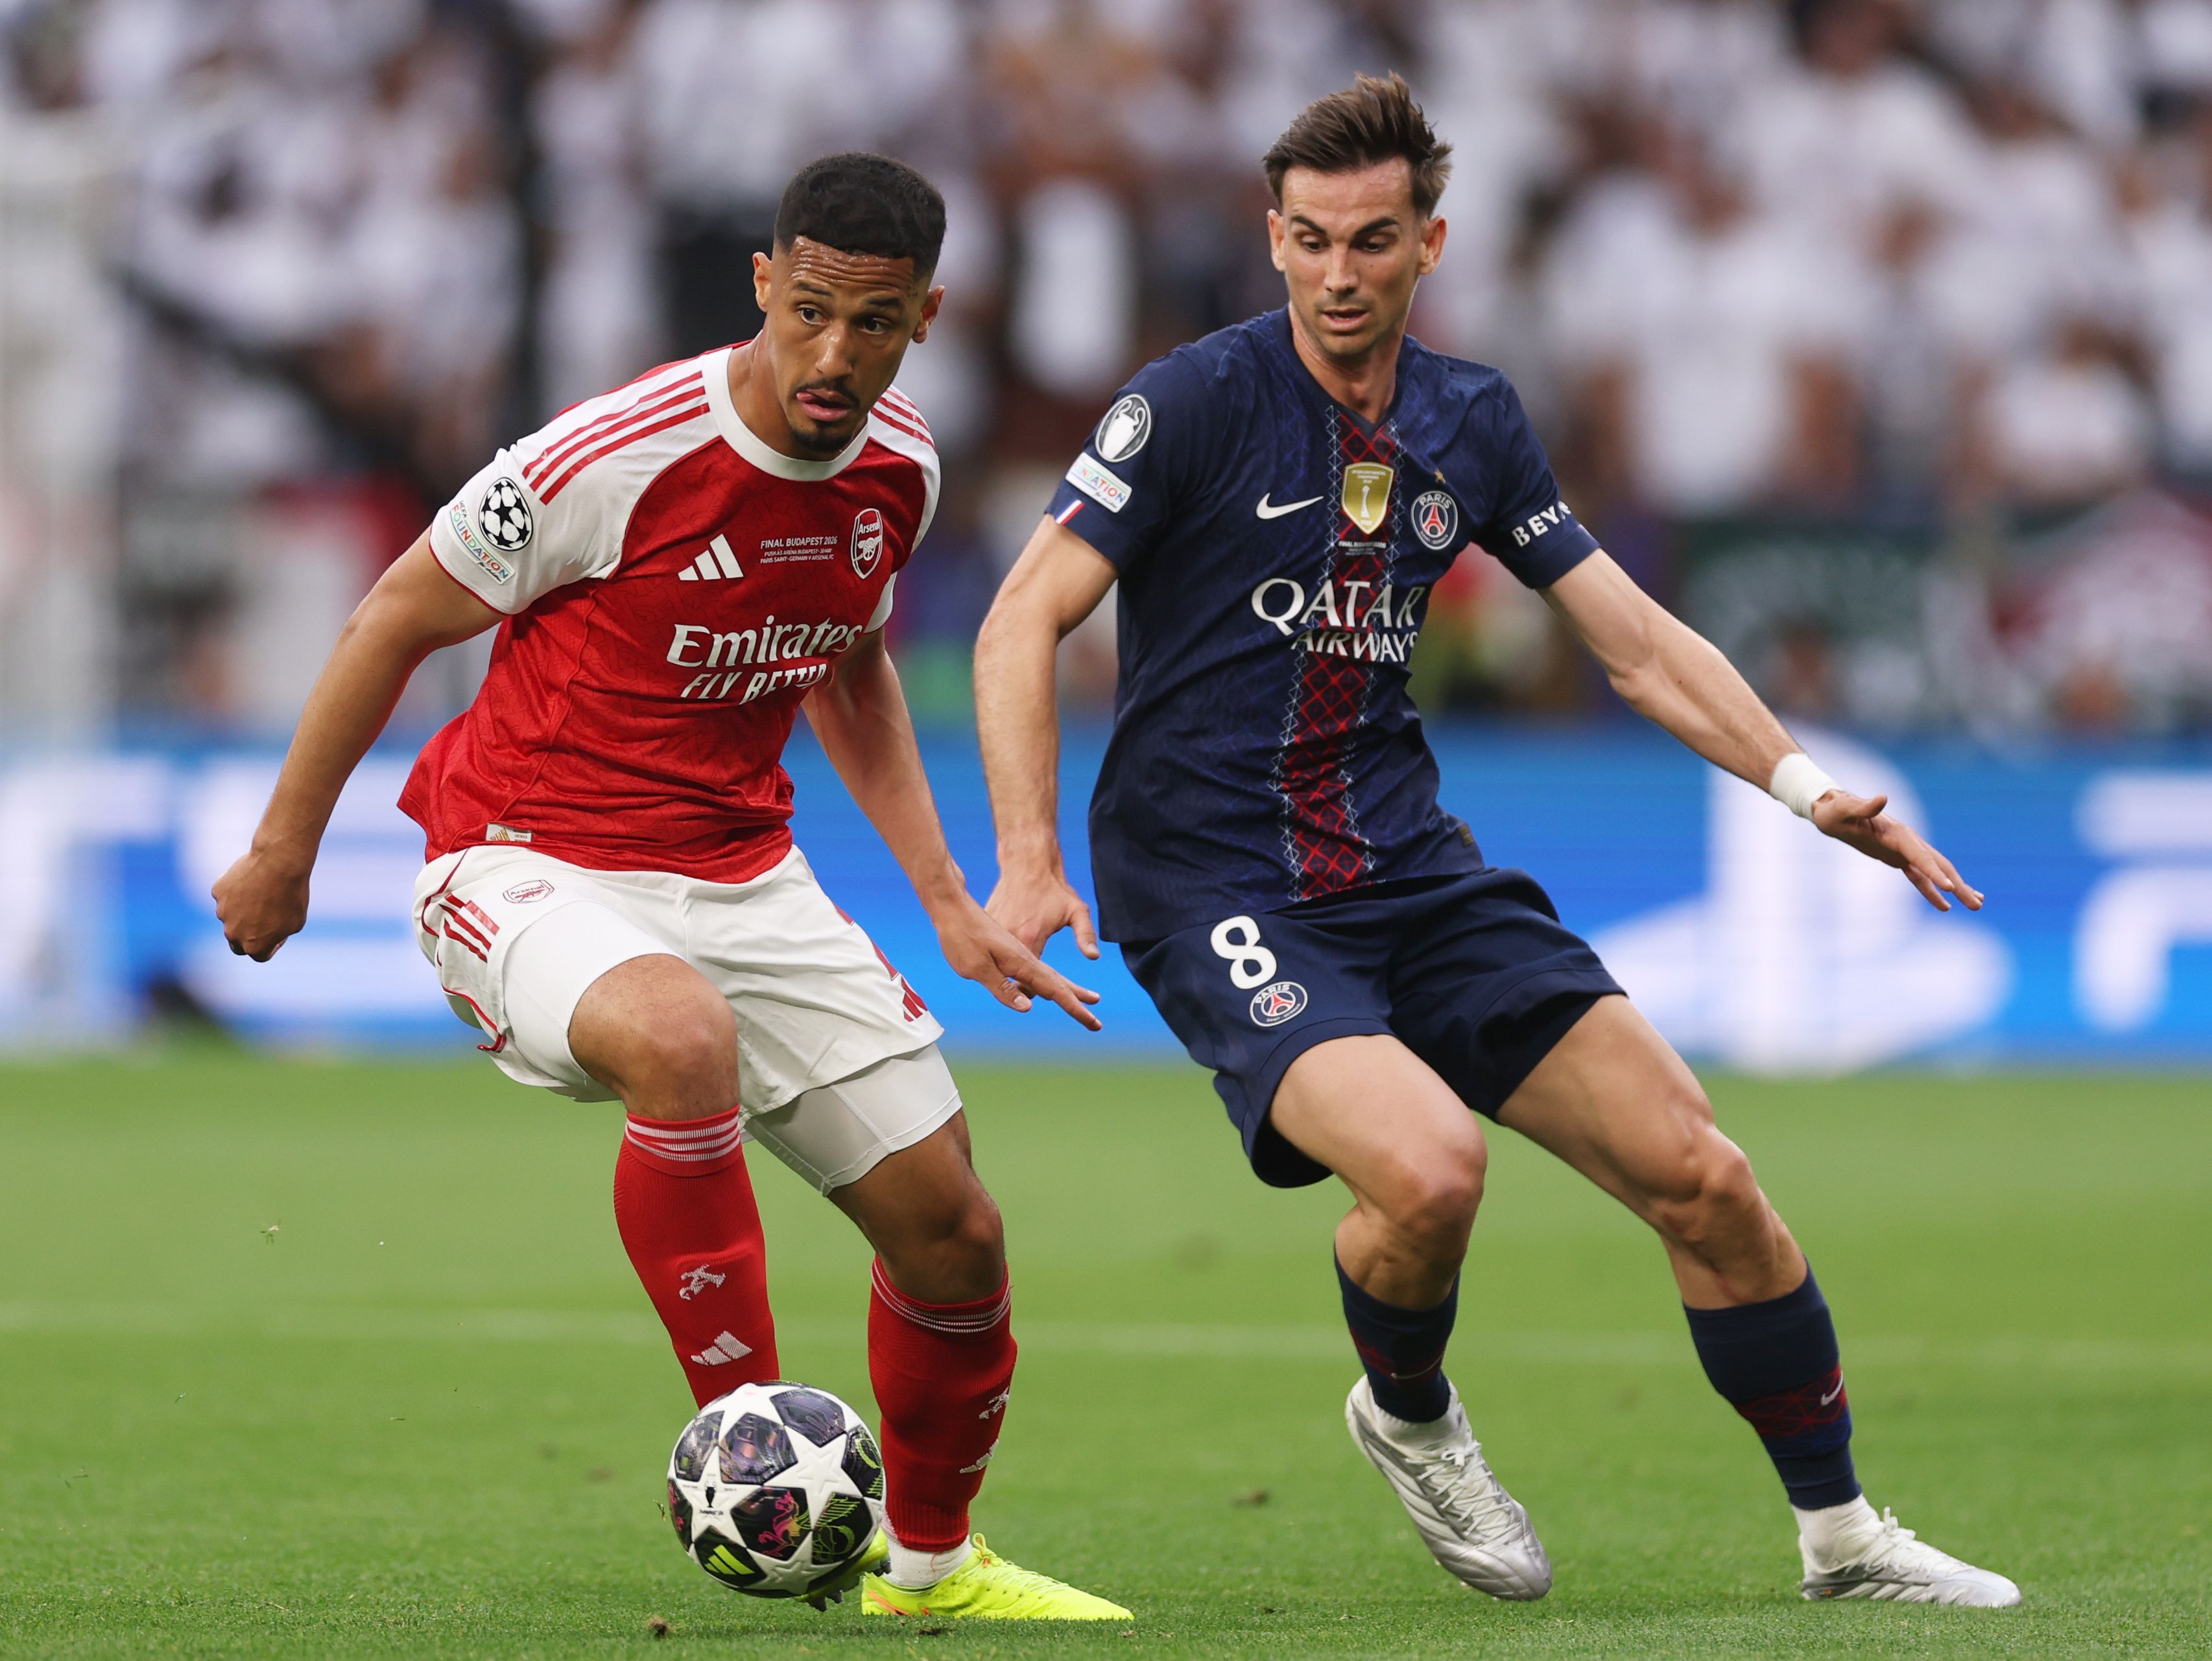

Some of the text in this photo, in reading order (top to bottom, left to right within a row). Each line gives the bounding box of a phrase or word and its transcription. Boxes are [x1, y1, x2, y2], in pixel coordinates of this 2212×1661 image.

[458, 500, 468, 518] UEFA
[1418, 493, 1452, 509] PARIS
[858, 519, 880, 534] Arsenal
[453, 504, 508, 578] FOUNDATION
[761, 539, 783, 548] FINAL
[786, 537, 824, 547] BUDAPEST
[1251, 578, 1425, 636] QATAR
[666, 615, 863, 668] Emirates
[680, 671, 743, 700] FLY
[1210, 915, 1277, 989] 8
[1254, 984, 1290, 1004] PARIS
